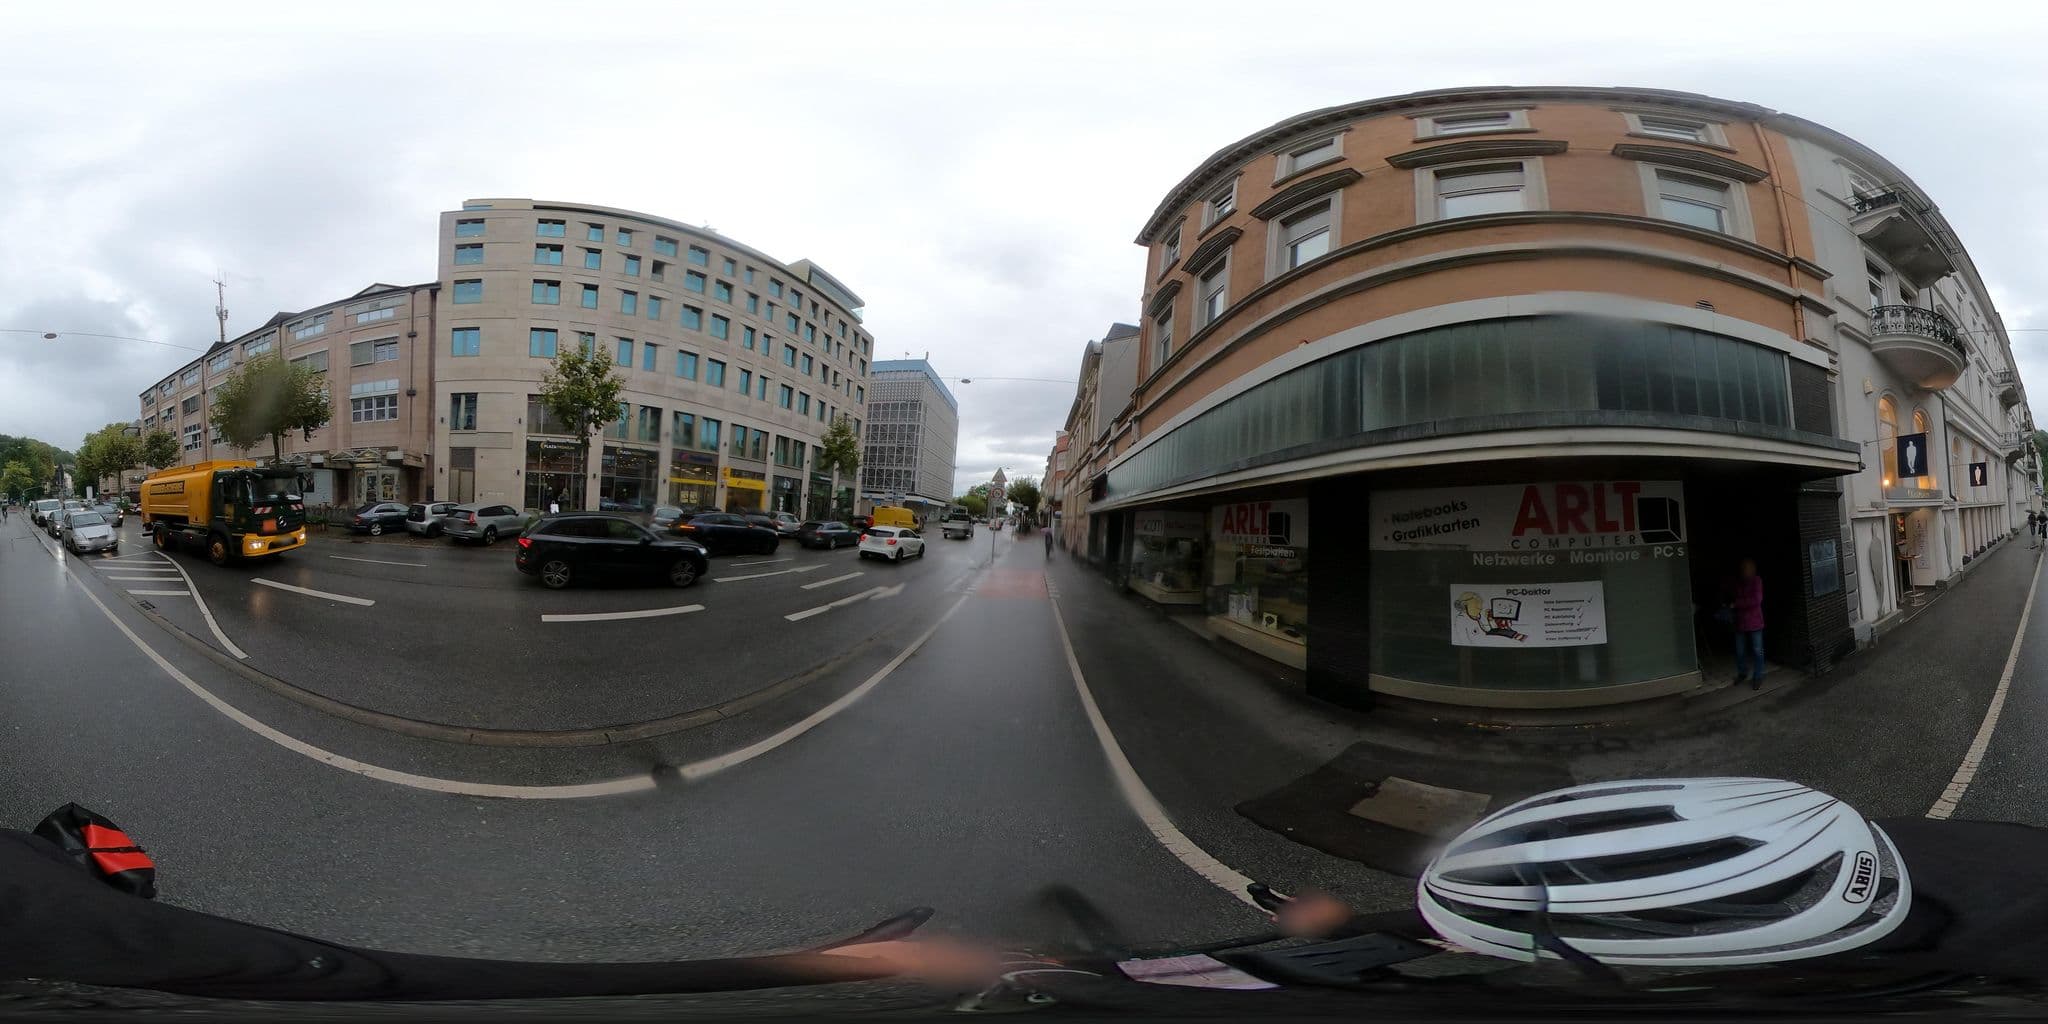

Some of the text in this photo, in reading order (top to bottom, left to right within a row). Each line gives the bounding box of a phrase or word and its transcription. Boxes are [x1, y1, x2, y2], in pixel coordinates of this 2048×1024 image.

[1222, 502, 1273, 535] ARLT
[1392, 500, 1468, 523] Notebooks
[1512, 482, 1640, 536] ARLT
[1392, 517, 1480, 542] Grafikkarten
[1511, 534, 1637, 549] COMPUTER
[1472, 551, 1556, 567] Netzwerke
[1569, 548, 1641, 564] Monitore
[1506, 588, 1551, 596] PC-Doktor
[1851, 857, 1873, 898] ABUS
